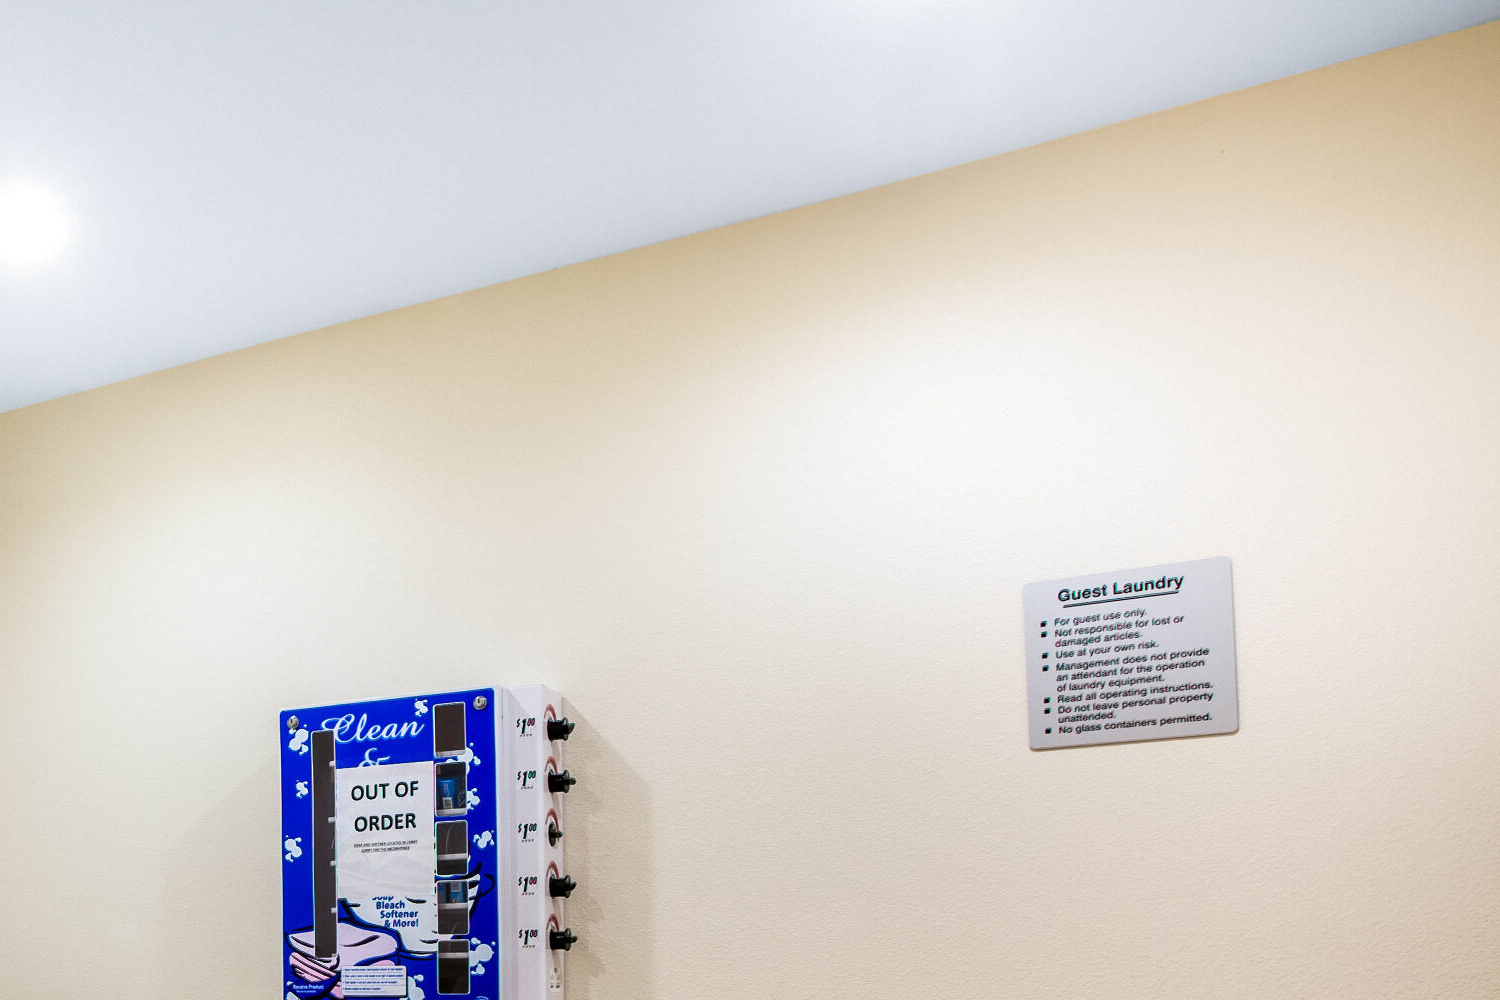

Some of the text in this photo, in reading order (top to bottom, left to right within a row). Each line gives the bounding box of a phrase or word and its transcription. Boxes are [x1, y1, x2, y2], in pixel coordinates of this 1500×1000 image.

[1058, 576, 1185, 602] Guest Laundry
[1054, 608, 1147, 627] For guest use only.
[1055, 616, 1185, 638] Not responsible for lost or
[1055, 631, 1143, 648] damaged articles.
[1056, 640, 1159, 659] Use at your own risk.
[1056, 648, 1210, 672] Management does not provide
[1056, 660, 1205, 682] an attendant for the operation
[1056, 675, 1165, 692] of laundry equipment.
[1058, 681, 1214, 703] Read all operating instructions.
[1058, 692, 1214, 714] Do not leave personal property
[321, 712, 425, 743] Clean
[1058, 712, 1116, 724] unattended.
[1058, 712, 1213, 735] No glass containers permitted.
[351, 780, 419, 801] OUT OF
[354, 812, 417, 832] ORDER
[376, 900, 405, 910] Bleach
[380, 910, 419, 919] Softener
[393, 919, 419, 927] More!
